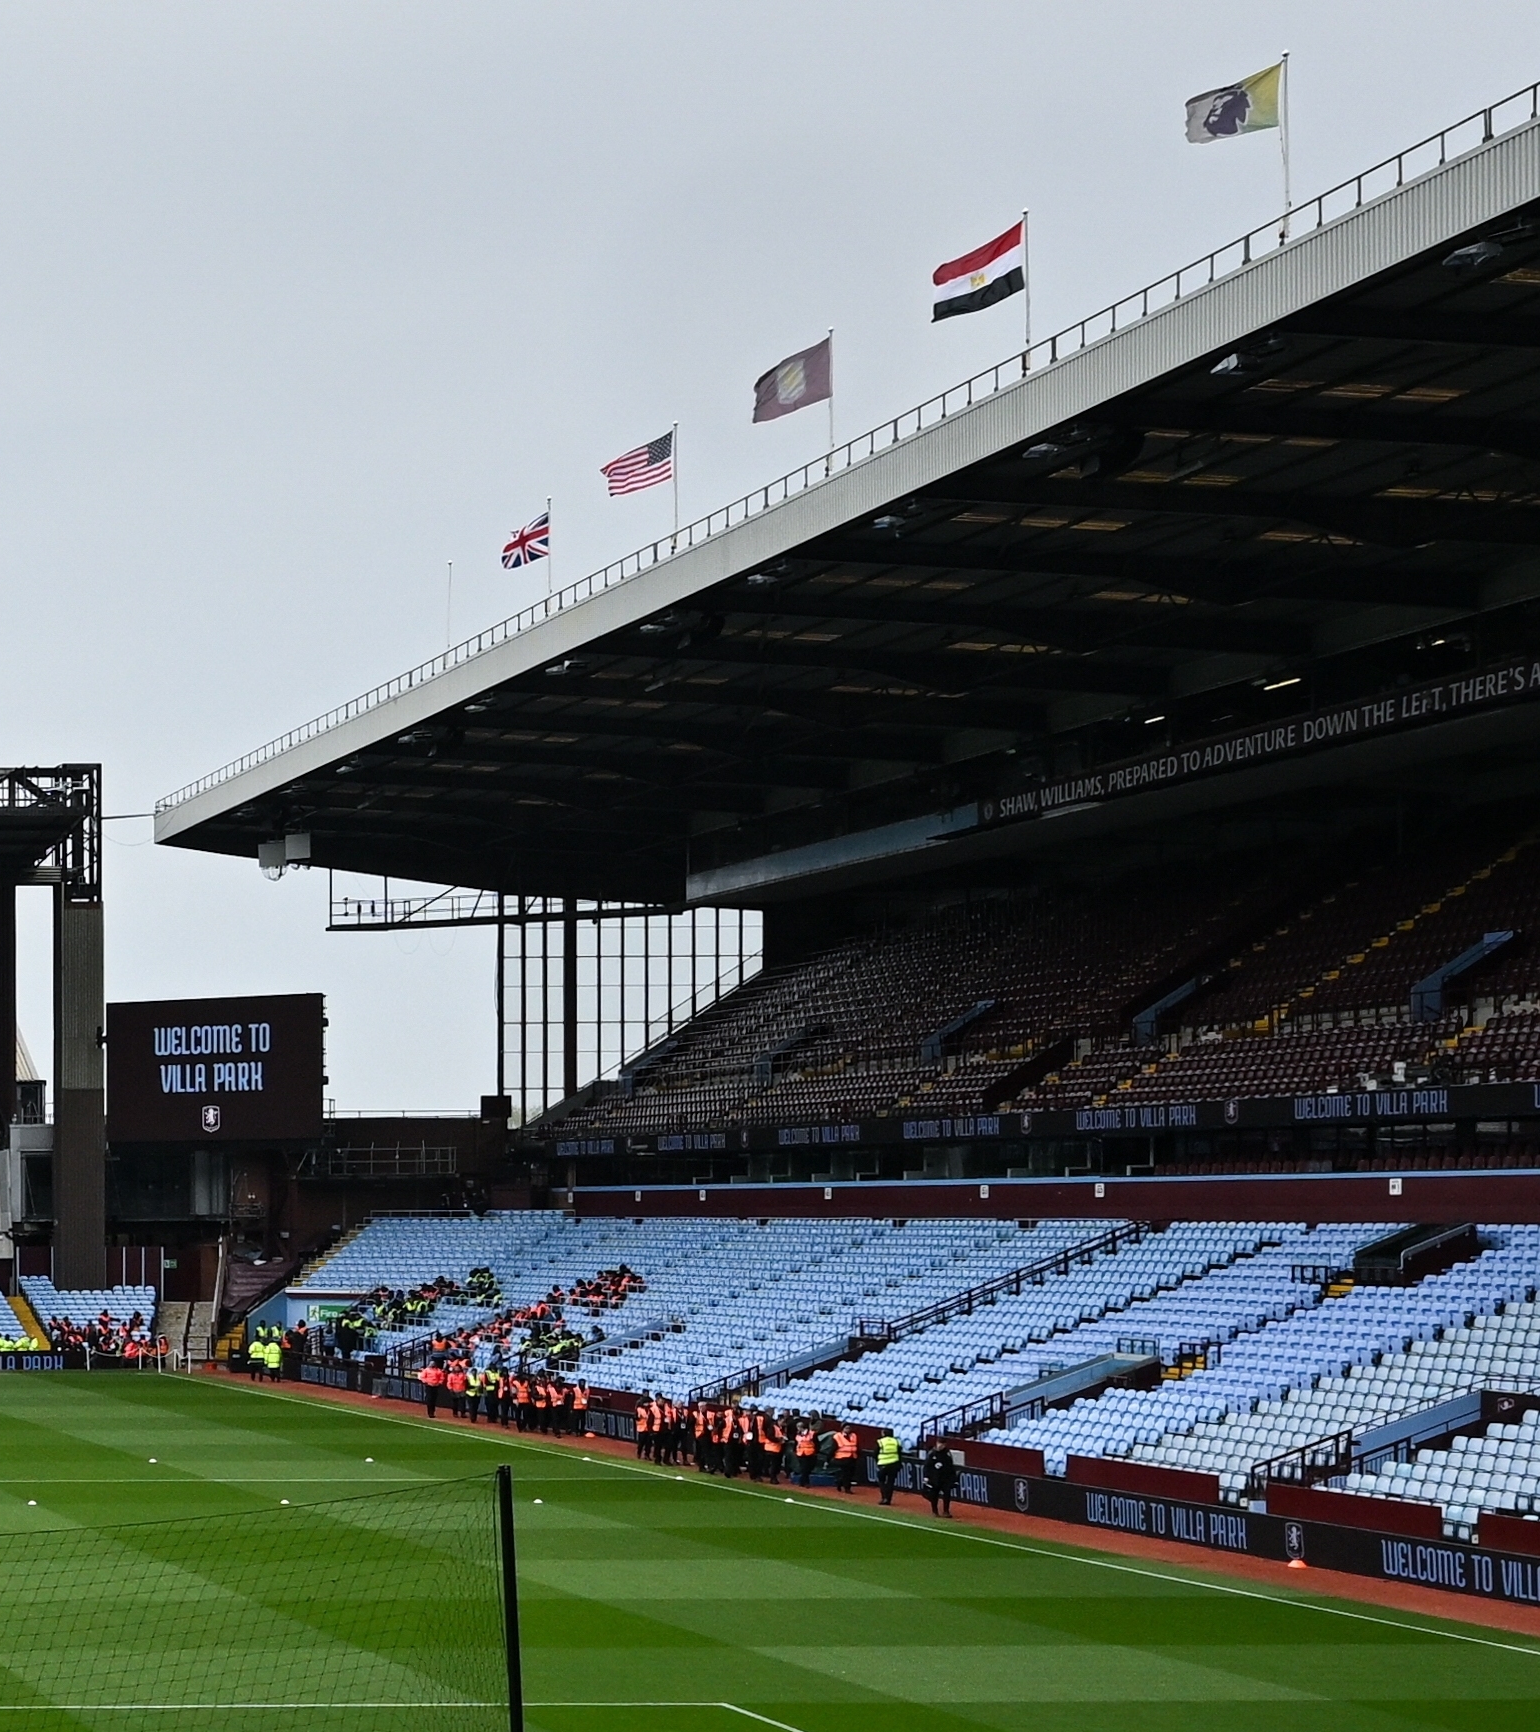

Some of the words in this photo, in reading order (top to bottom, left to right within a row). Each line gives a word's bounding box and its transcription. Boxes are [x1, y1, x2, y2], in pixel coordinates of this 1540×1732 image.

[999, 790, 1038, 818] SHAW,
[1040, 775, 1105, 807] WILLIAMS,
[1108, 755, 1178, 792] PREPARED
[1180, 749, 1201, 772] TO
[1202, 724, 1296, 769] ADVENTURE
[1303, 707, 1358, 744] DOWN
[1361, 698, 1396, 729] THE
[1449, 665, 1525, 707] THERE'S
[153, 1023, 243, 1056] WELCOME
[248, 1022, 271, 1053] TO
[159, 1062, 208, 1094] VILLA
[213, 1060, 264, 1092] PARK
[1075, 1108, 1121, 1131] WELCOME
[1124, 1108, 1136, 1128] TO
[1139, 1106, 1166, 1128] VILLA
[1168, 1105, 1197, 1126] PARK
[1294, 1094, 1352, 1120] WELCOME
[1355, 1093, 1370, 1116] TO
[1375, 1091, 1408, 1116] VILLA
[1412, 1089, 1448, 1114] PARK
[903, 1120, 940, 1140] WELCOME
[941, 1119, 952, 1137] TO
[953, 1118, 974, 1137] VILLA
[976, 1116, 1000, 1136] PARK
[959, 1472, 989, 1504] PARK
[1086, 1491, 1146, 1531] WELCOME
[1149, 1502, 1166, 1535] TO
[1170, 1505, 1206, 1543] VILLA
[1209, 1512, 1248, 1550] PARK
[1381, 1538, 1466, 1588] WELCOME
[1470, 1554, 1493, 1592] TO
[1500, 1558, 1540, 1602] VILL
